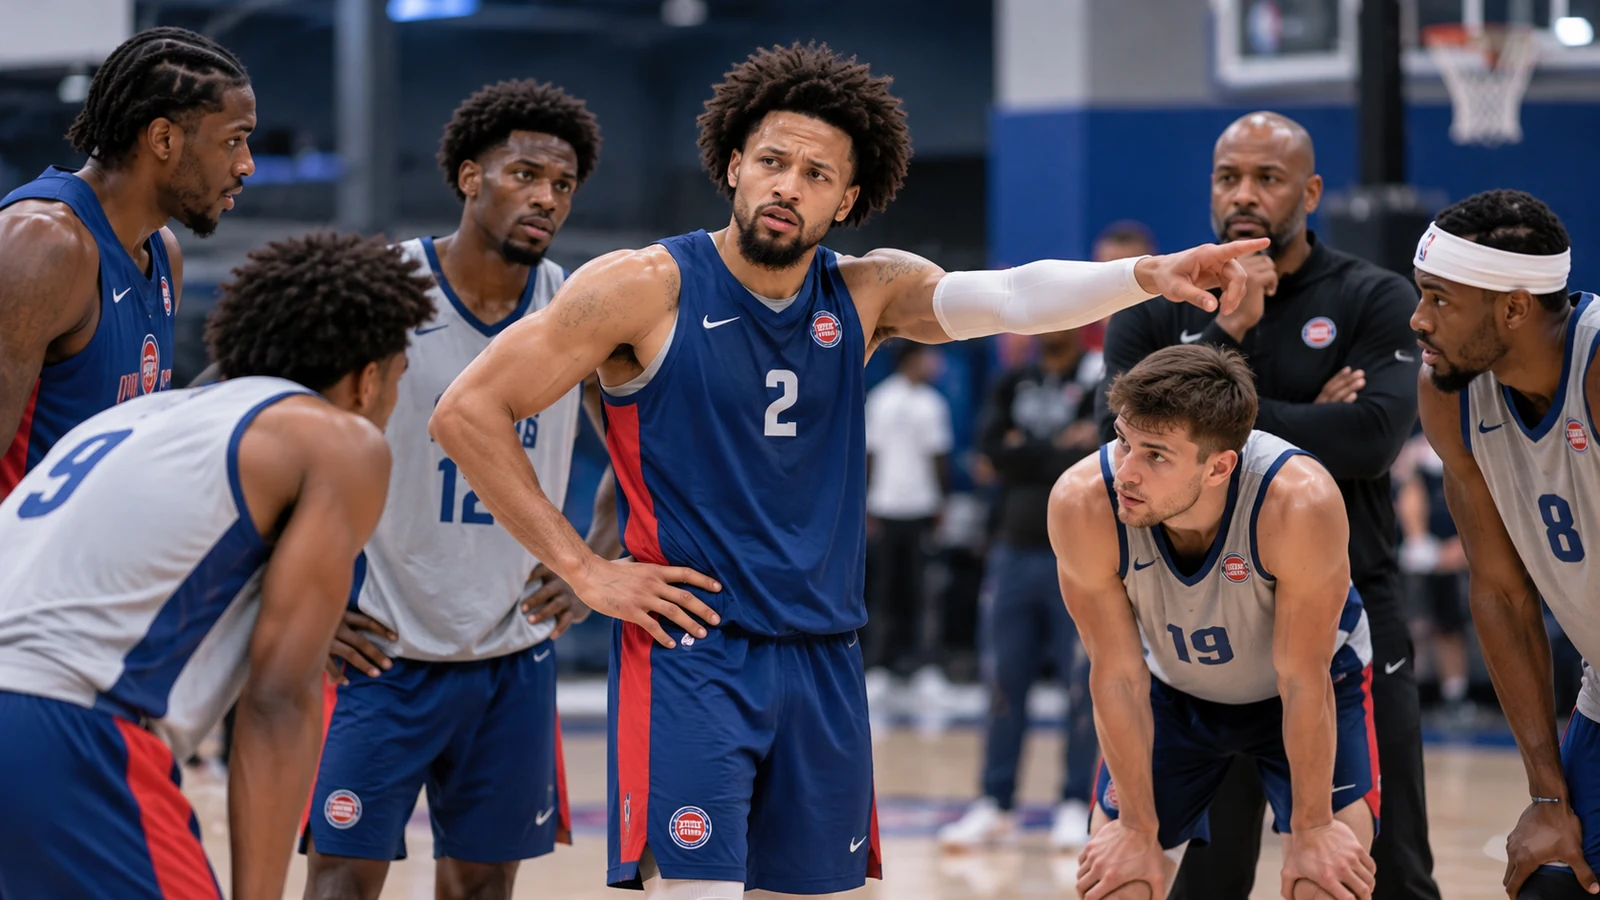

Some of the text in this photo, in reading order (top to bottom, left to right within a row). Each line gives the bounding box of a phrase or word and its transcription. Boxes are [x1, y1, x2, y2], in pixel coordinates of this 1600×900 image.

[764, 369, 798, 437] 2
[17, 428, 133, 519] 9
[1537, 493, 1586, 563] 8
[1166, 623, 1234, 667] 19
